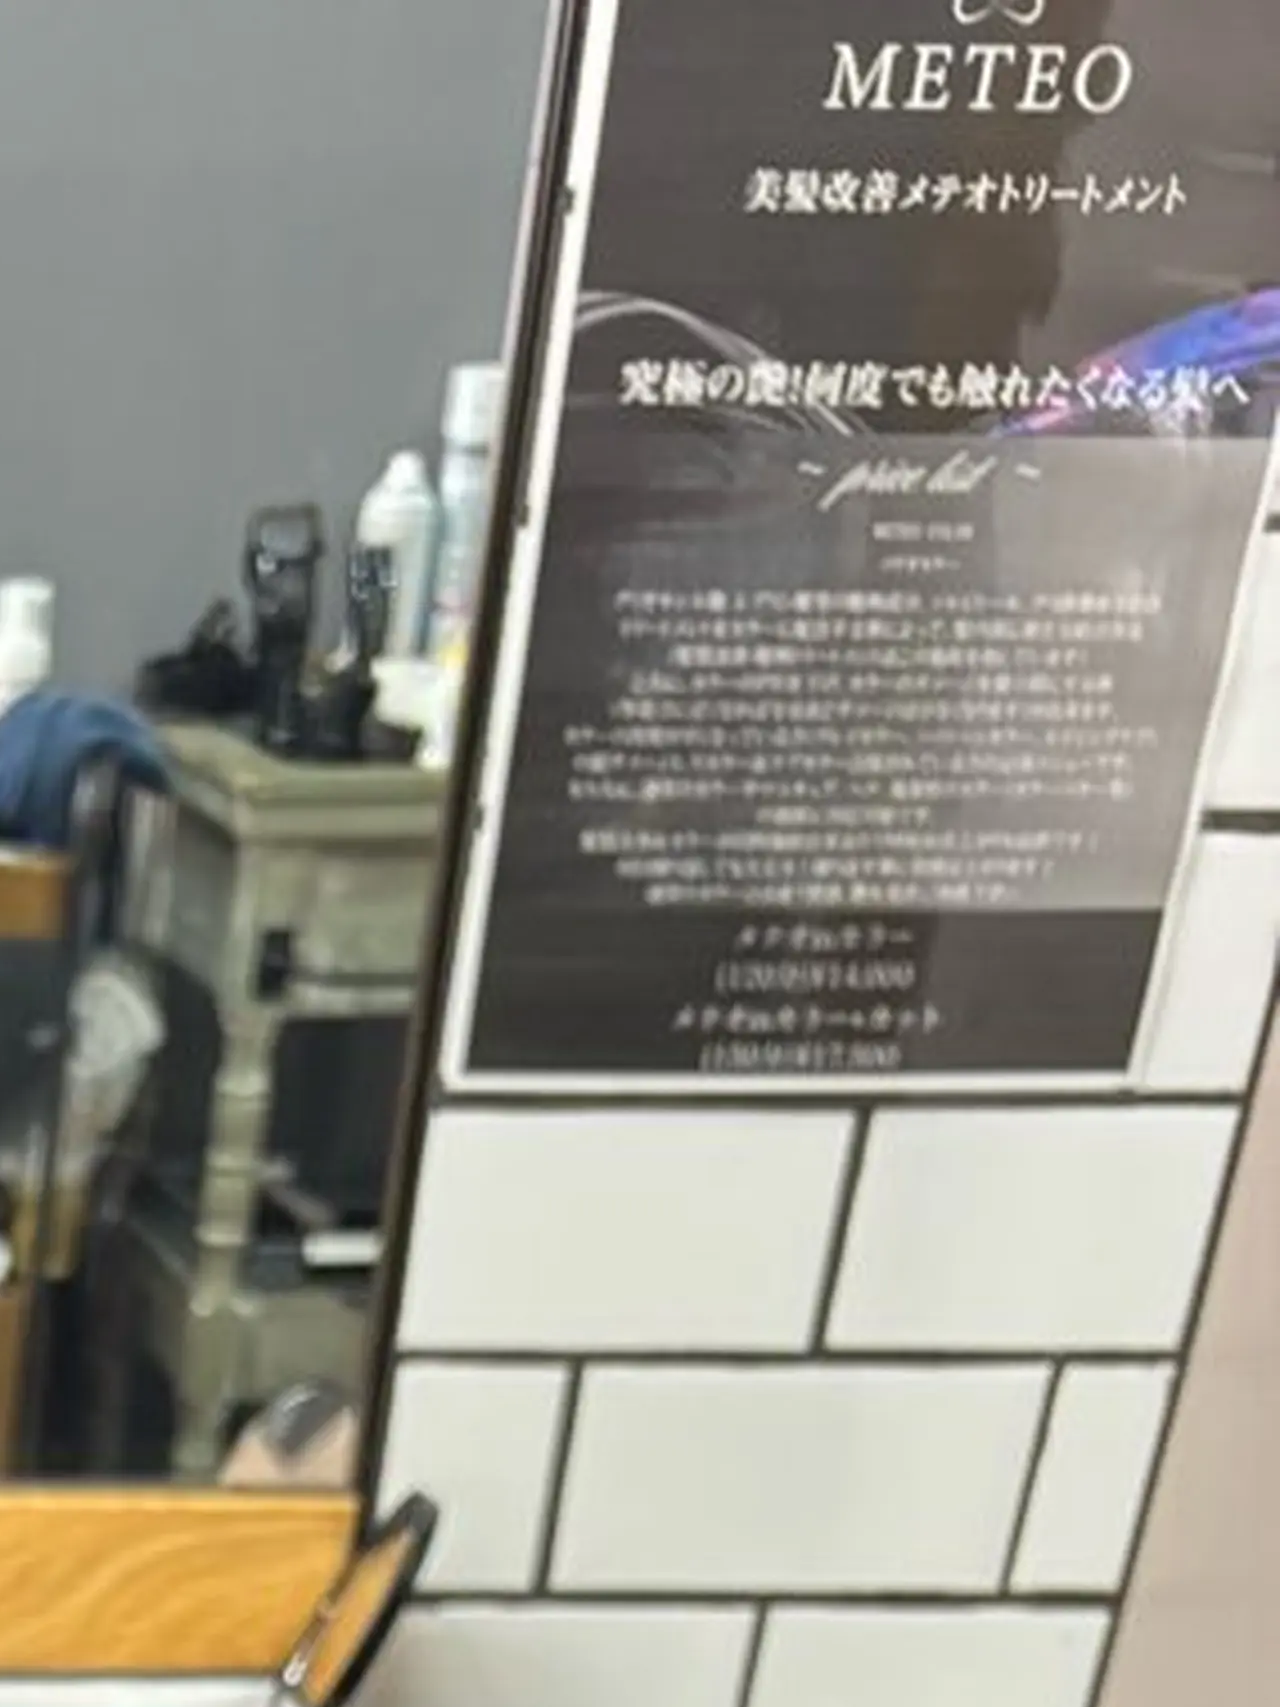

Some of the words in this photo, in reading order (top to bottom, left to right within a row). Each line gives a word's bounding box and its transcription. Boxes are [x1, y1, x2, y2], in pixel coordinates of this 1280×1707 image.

[824, 43, 1132, 113] METEO
[744, 167, 1187, 216] 美髪改善メテオトリートメント
